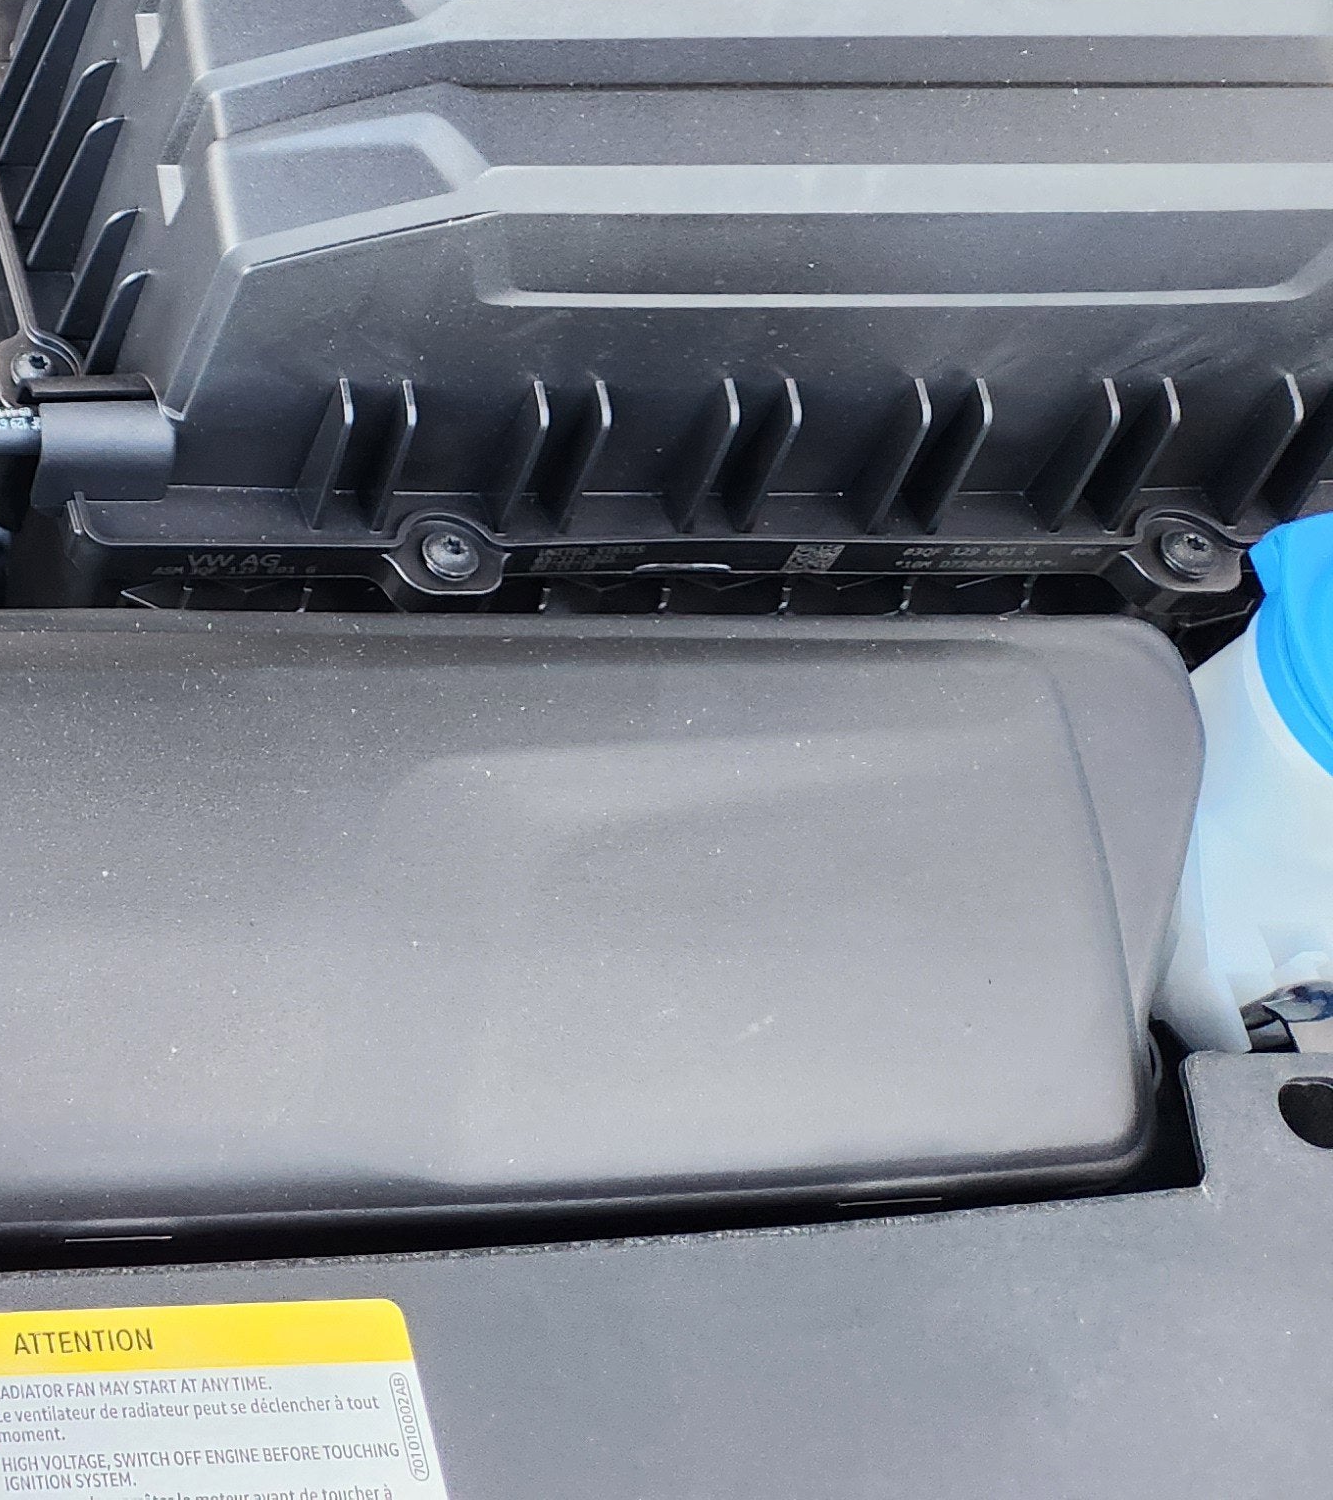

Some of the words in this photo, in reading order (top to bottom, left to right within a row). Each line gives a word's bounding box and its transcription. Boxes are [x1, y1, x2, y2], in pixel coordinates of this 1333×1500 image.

[187, 552, 234, 567] VW
[240, 553, 282, 567] AG
[14, 1327, 154, 1356] ATTENTION
[66, 1381, 96, 1398] FAN
[99, 1380, 130, 1396] MAY
[134, 1379, 177, 1395] START
[181, 1378, 197, 1393] AT
[201, 1377, 231, 1393] ANY
[232, 1376, 272, 1391] TIME.
[14, 1405, 96, 1423] ventilateur
[100, 1403, 118, 1419] de
[122, 1401, 190, 1418] radiateur
[194, 1401, 227, 1419] peut
[231, 1403, 247, 1416] se
[251, 1397, 332, 1414] déclencher
[334, 1394, 344, 1411] à
[348, 1396, 380, 1411] tout
[2, 1456, 39, 1473] HIGH
[40, 1454, 111, 1471] VOLTAGE,
[113, 1451, 170, 1468] SWITCH
[173, 1450, 202, 1466] OFF
[206, 1448, 260, 1464] ENGINE
[263, 1446, 321, 1462] BEFORE
[322, 1443, 400, 1459] TOUCHING
[5, 1475, 72, 1492] IGNITION
[75, 1472, 137, 1488] SYSTEM.
